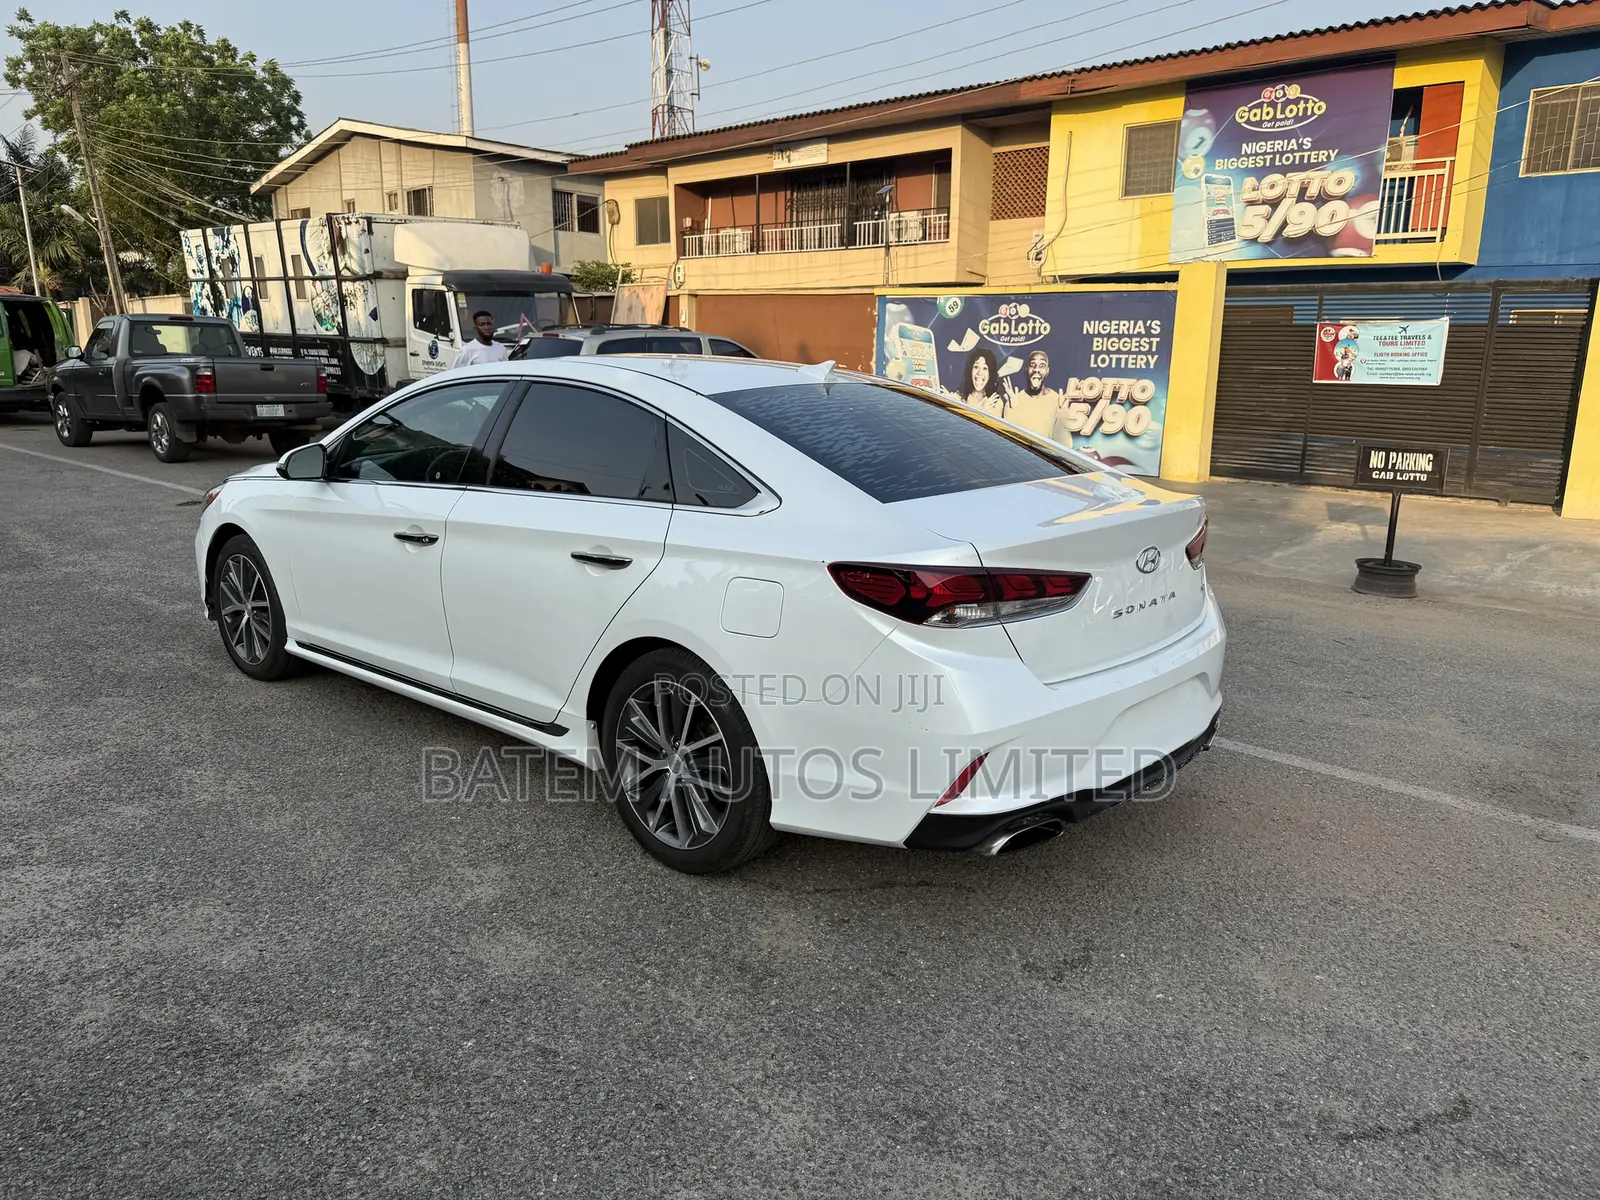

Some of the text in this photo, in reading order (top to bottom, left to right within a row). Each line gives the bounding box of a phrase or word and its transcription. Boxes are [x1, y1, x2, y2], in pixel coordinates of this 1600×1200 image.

[1276, 99, 1327, 118] Lotto
[1262, 119, 1294, 128] Get paid!
[1241, 137, 1312, 155] NIGERIA'S
[1215, 149, 1339, 171] BIGGEST LOTTERY
[1240, 168, 1355, 204] LOTTO
[1237, 198, 1350, 243] 5/90
[948, 300, 960, 313] 59
[1011, 319, 1051, 335] Lotto
[1083, 320, 1161, 335] NIGERIA'S
[1092, 337, 1160, 352] BIGGEST
[1090, 354, 1159, 369] LOTTERY
[1065, 377, 1156, 404] LOTTO
[1062, 399, 1152, 437] 5/90
[1369, 450, 1434, 472] NO PARKING
[1372, 470, 1428, 482] GAB LOTTO
[1112, 591, 1177, 619] SONATA
